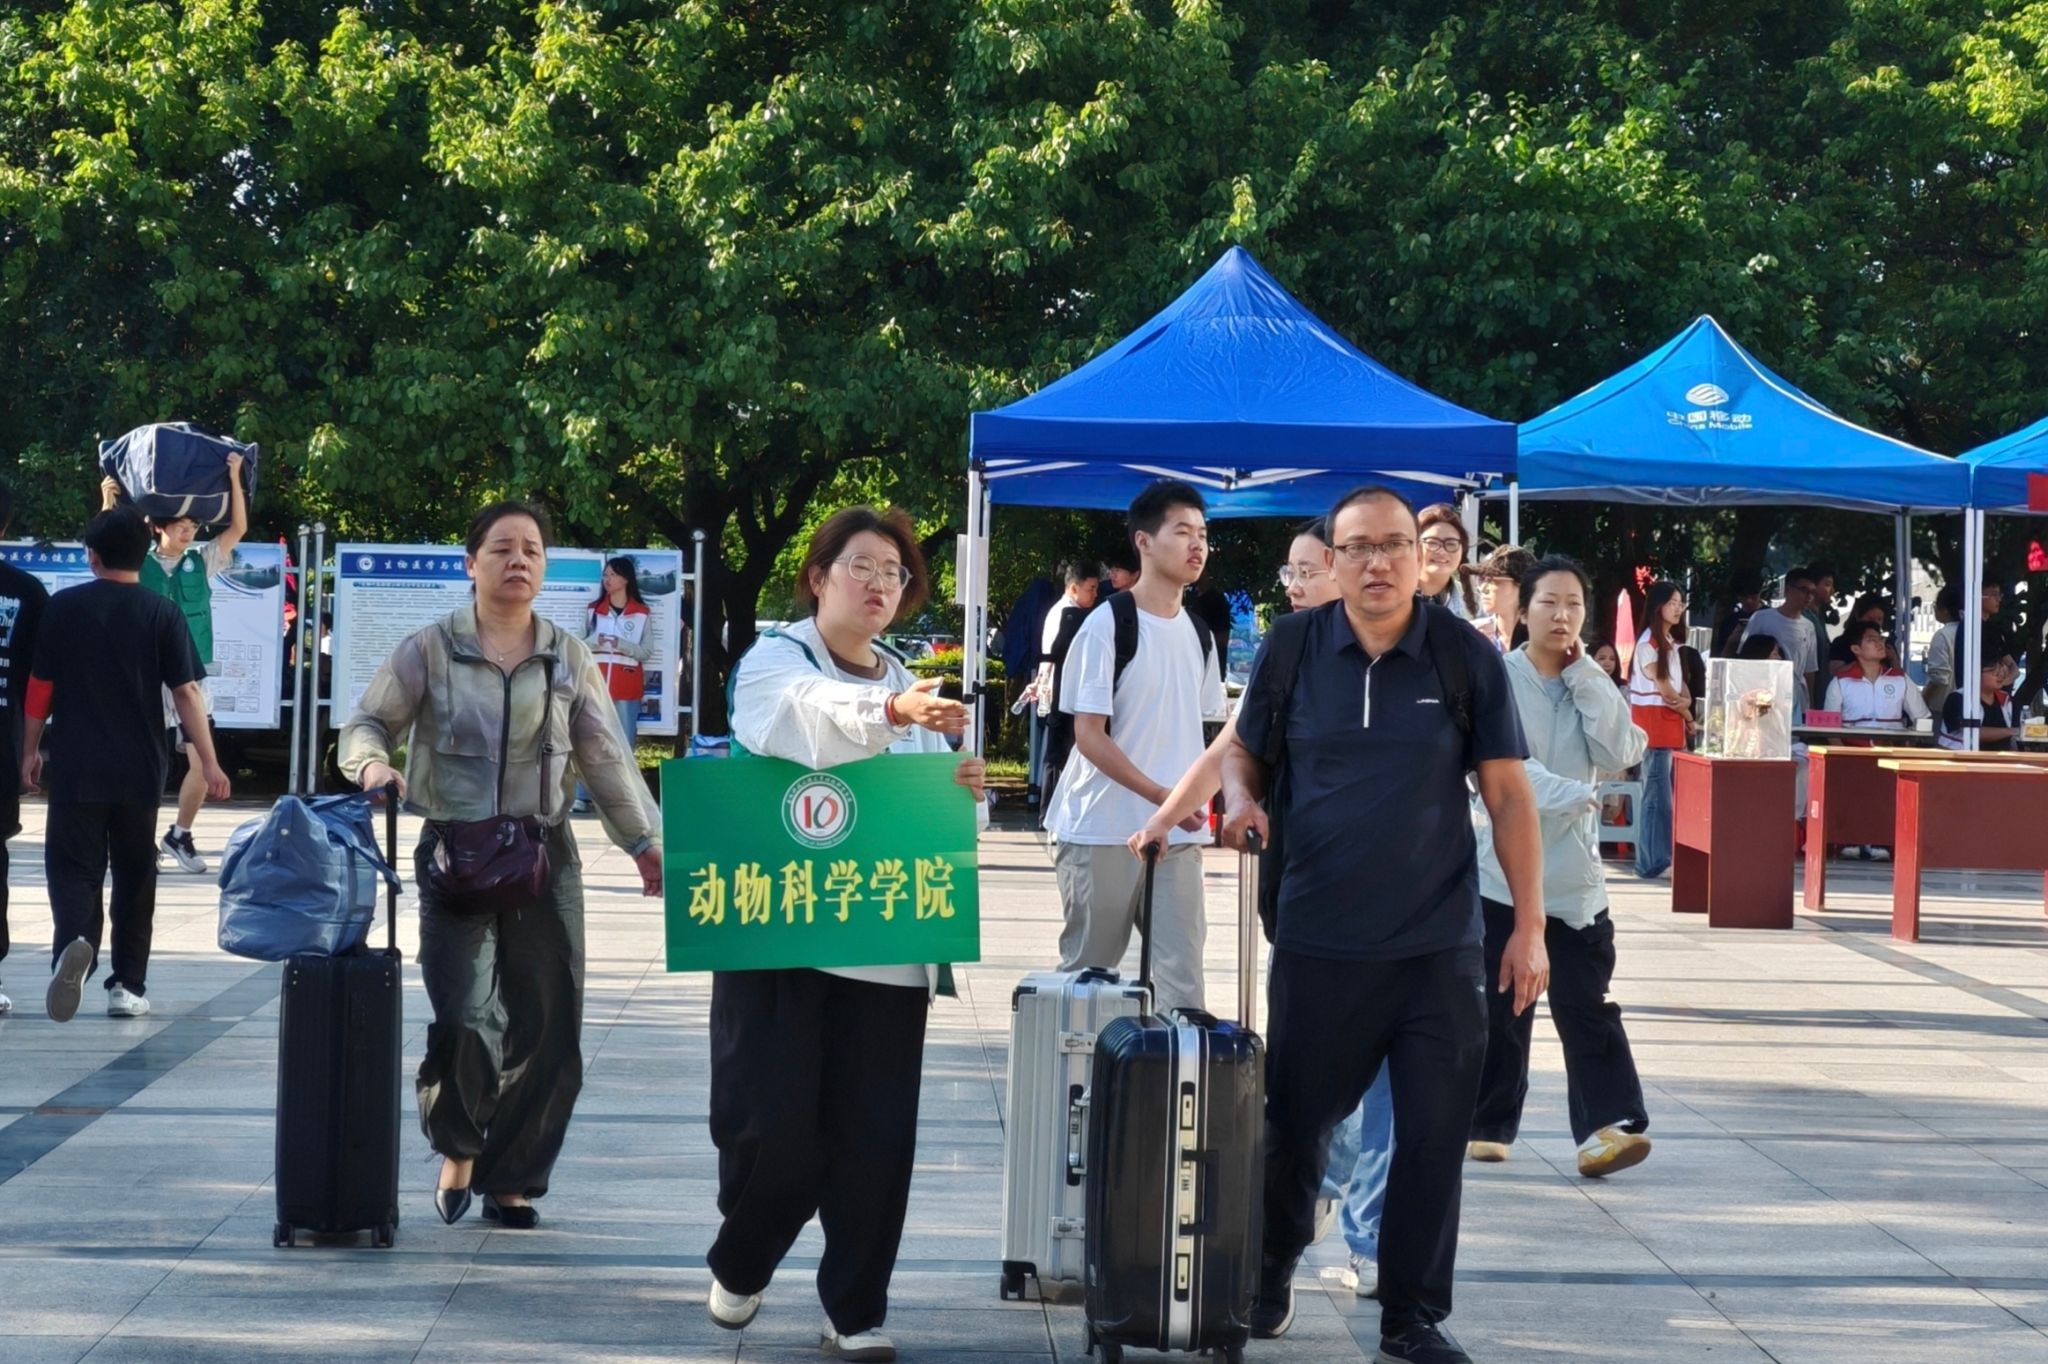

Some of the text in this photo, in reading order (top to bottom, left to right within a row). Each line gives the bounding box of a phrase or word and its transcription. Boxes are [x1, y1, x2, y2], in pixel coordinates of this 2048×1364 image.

[1667, 418, 1706, 431] Chna
[688, 855, 955, 926] 动物科学学院
